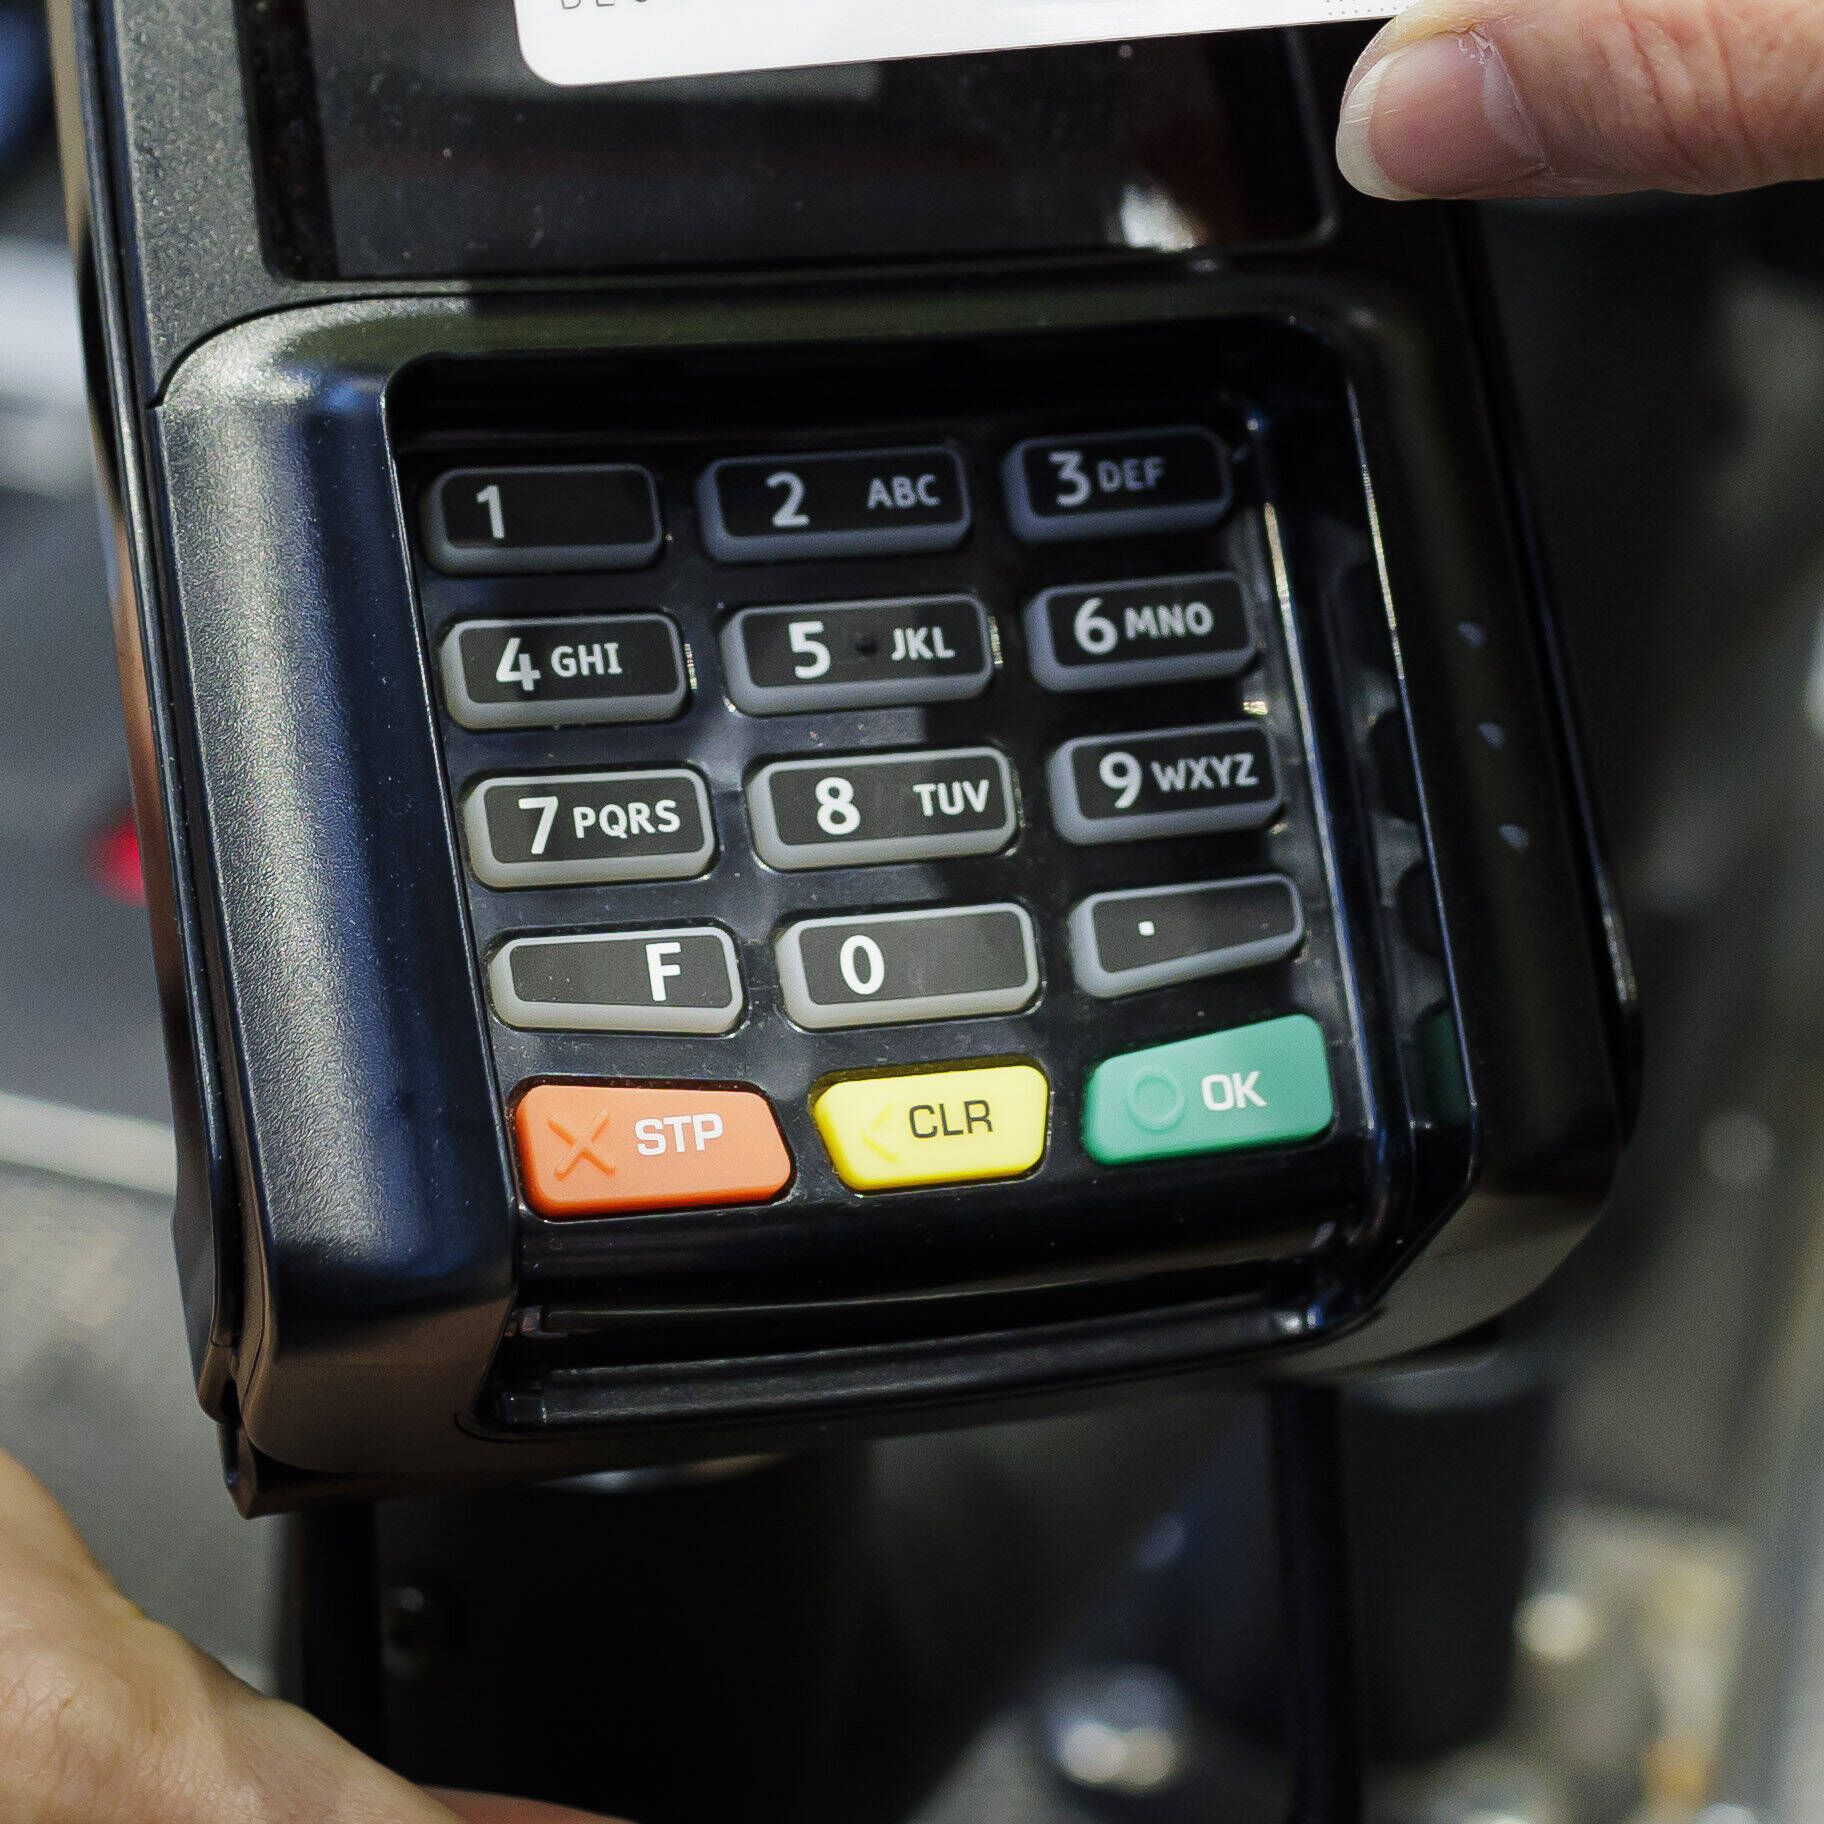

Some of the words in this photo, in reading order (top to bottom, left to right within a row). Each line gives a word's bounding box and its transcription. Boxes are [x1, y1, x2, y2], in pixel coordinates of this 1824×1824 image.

[765, 472, 810, 527] 2
[866, 474, 940, 510] ABC
[1048, 451, 1092, 506] 3
[1098, 458, 1163, 495] DEF
[476, 485, 505, 539] 1
[789, 622, 831, 679] 5
[891, 626, 955, 661] JKL
[1073, 599, 1117, 654] 6
[1124, 603, 1213, 639] MNO
[495, 637, 541, 691] 4
[550, 643, 622, 678] GHI
[815, 778, 860, 835] 8
[913, 779, 989, 817] TUV
[1098, 751, 1142, 808] 9
[1154, 752, 1259, 791] WXYZ
[517, 796, 559, 854] 7
[573, 799, 680, 840] PQRS
[645, 942, 681, 1002] F
[908, 1098, 993, 1140] CLR
[1200, 1072, 1267, 1112] OK
[633, 1113, 724, 1157] STP
